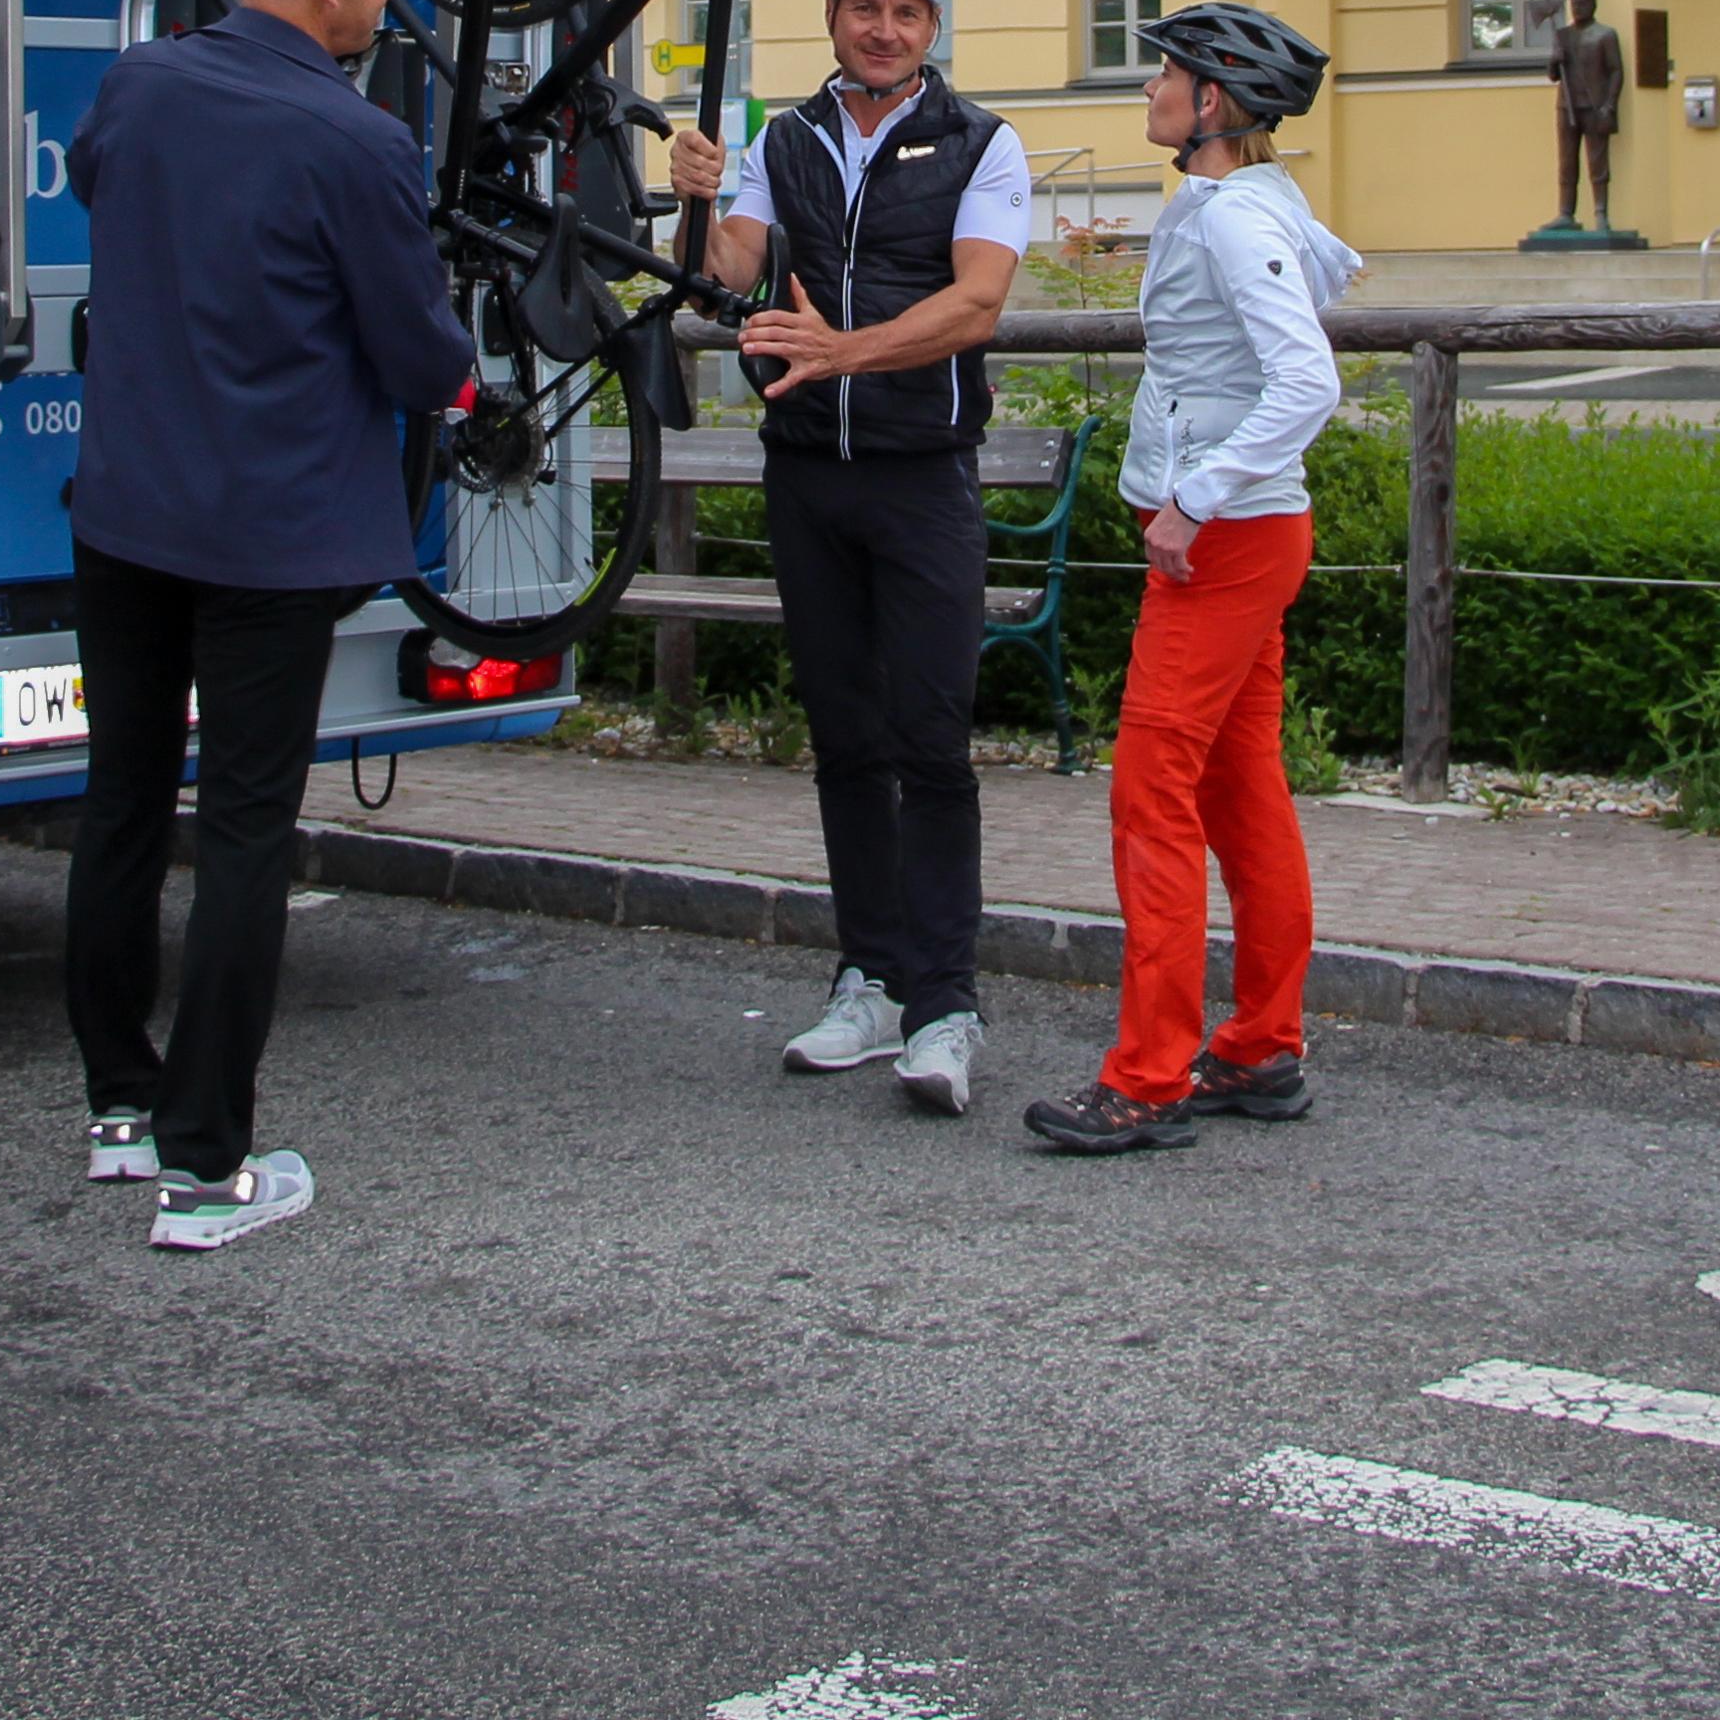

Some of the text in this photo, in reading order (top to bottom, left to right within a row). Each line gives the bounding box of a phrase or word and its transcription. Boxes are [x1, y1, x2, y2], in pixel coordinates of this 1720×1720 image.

[657, 44, 671, 67] H
[25, 400, 82, 435] 080
[18, 678, 67, 726] OW
